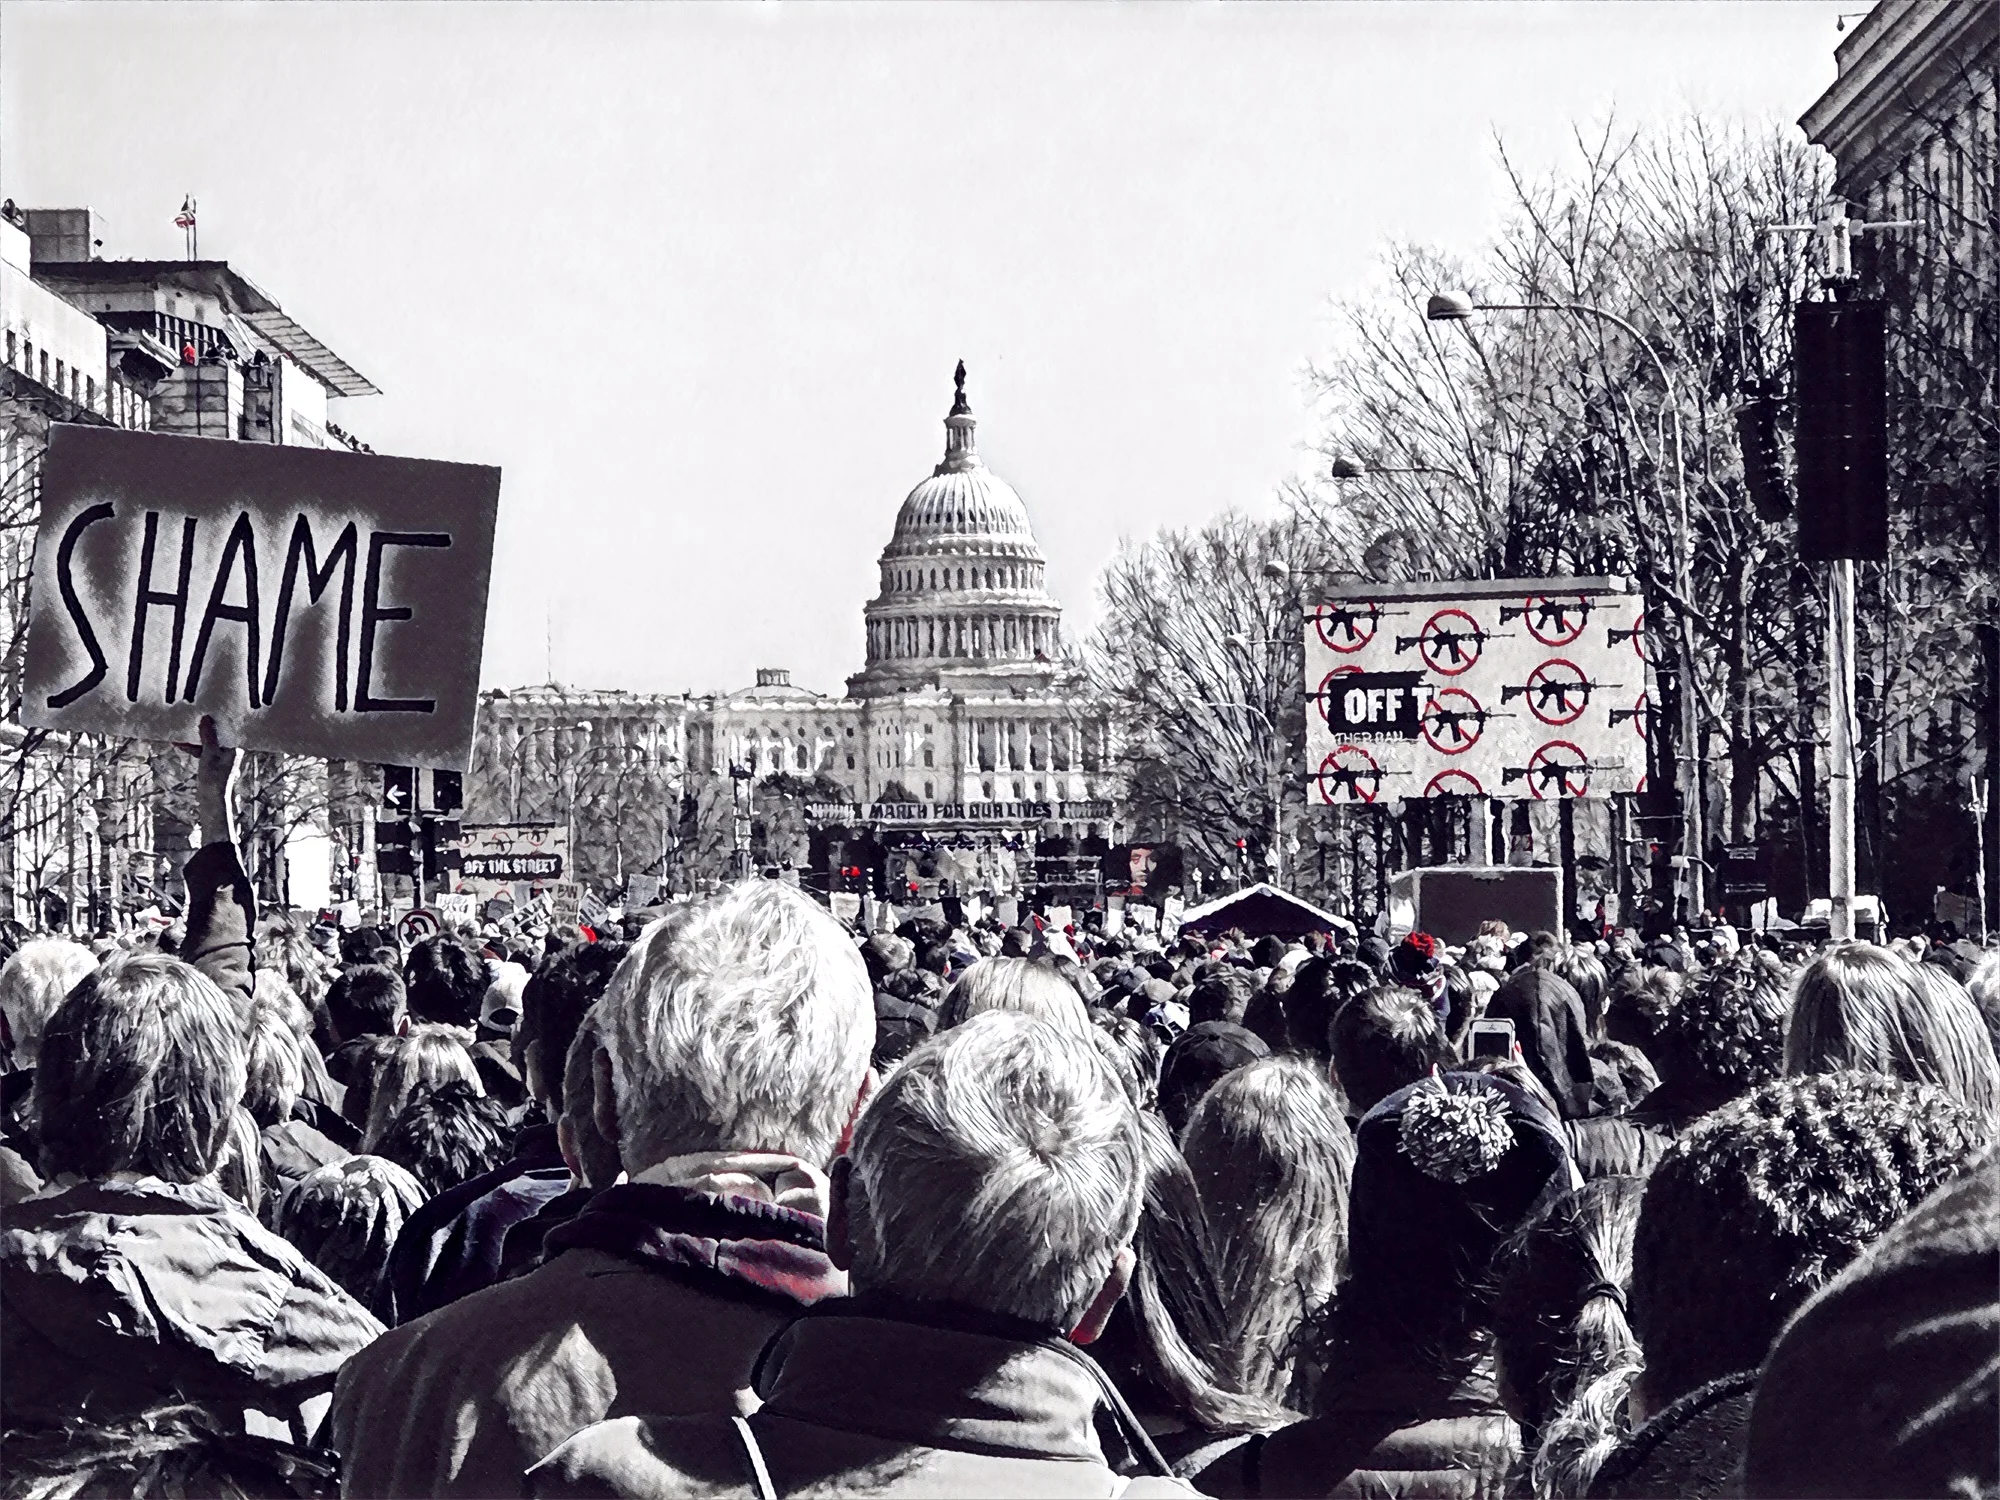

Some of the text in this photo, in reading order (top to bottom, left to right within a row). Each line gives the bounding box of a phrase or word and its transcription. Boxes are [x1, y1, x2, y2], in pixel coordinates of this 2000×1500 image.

[47, 502, 452, 713] SHAME
[1344, 688, 1404, 724] OFF
[869, 803, 928, 819] MARCH
[933, 803, 966, 819] FOR
[969, 803, 1004, 818] OUR
[1006, 802, 1052, 818] LIVES
